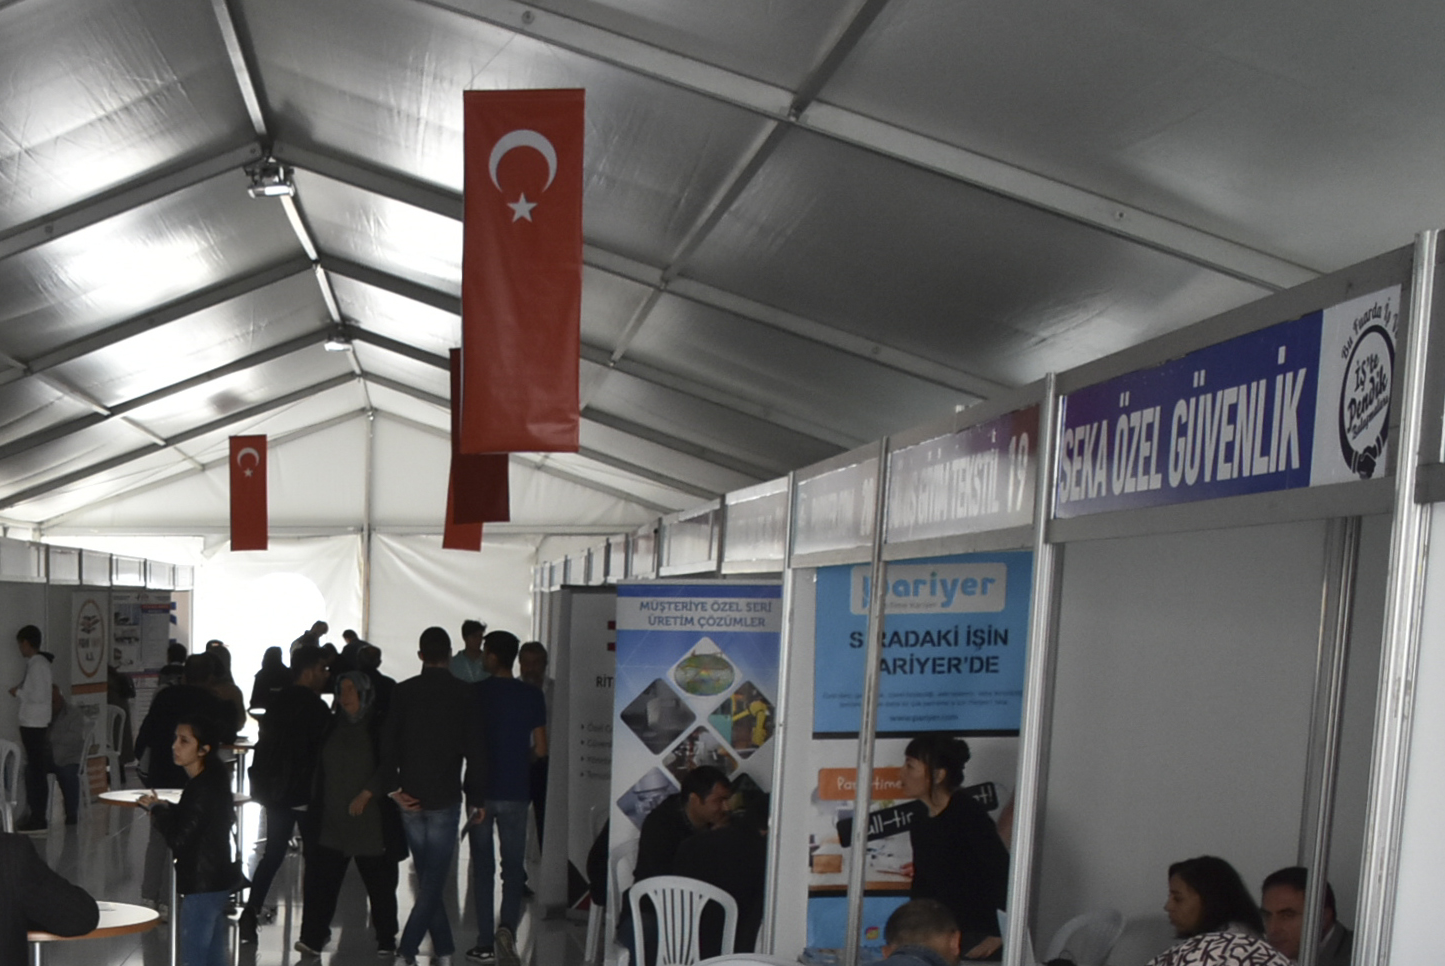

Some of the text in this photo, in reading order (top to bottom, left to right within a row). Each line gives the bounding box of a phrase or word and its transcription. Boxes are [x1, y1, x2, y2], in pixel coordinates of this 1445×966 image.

[1347, 364, 1388, 434] Pendik
[1060, 346, 1307, 503] SEKA ÖZEL GÜVENLİK
[1007, 431, 1029, 513] 19
[639, 599, 772, 613] MÜŞTERİYE ÖZEL SERİ
[648, 613, 765, 628] ÜRETİM ÇÖZÜMLER
[966, 625, 1008, 651] İŞİN
